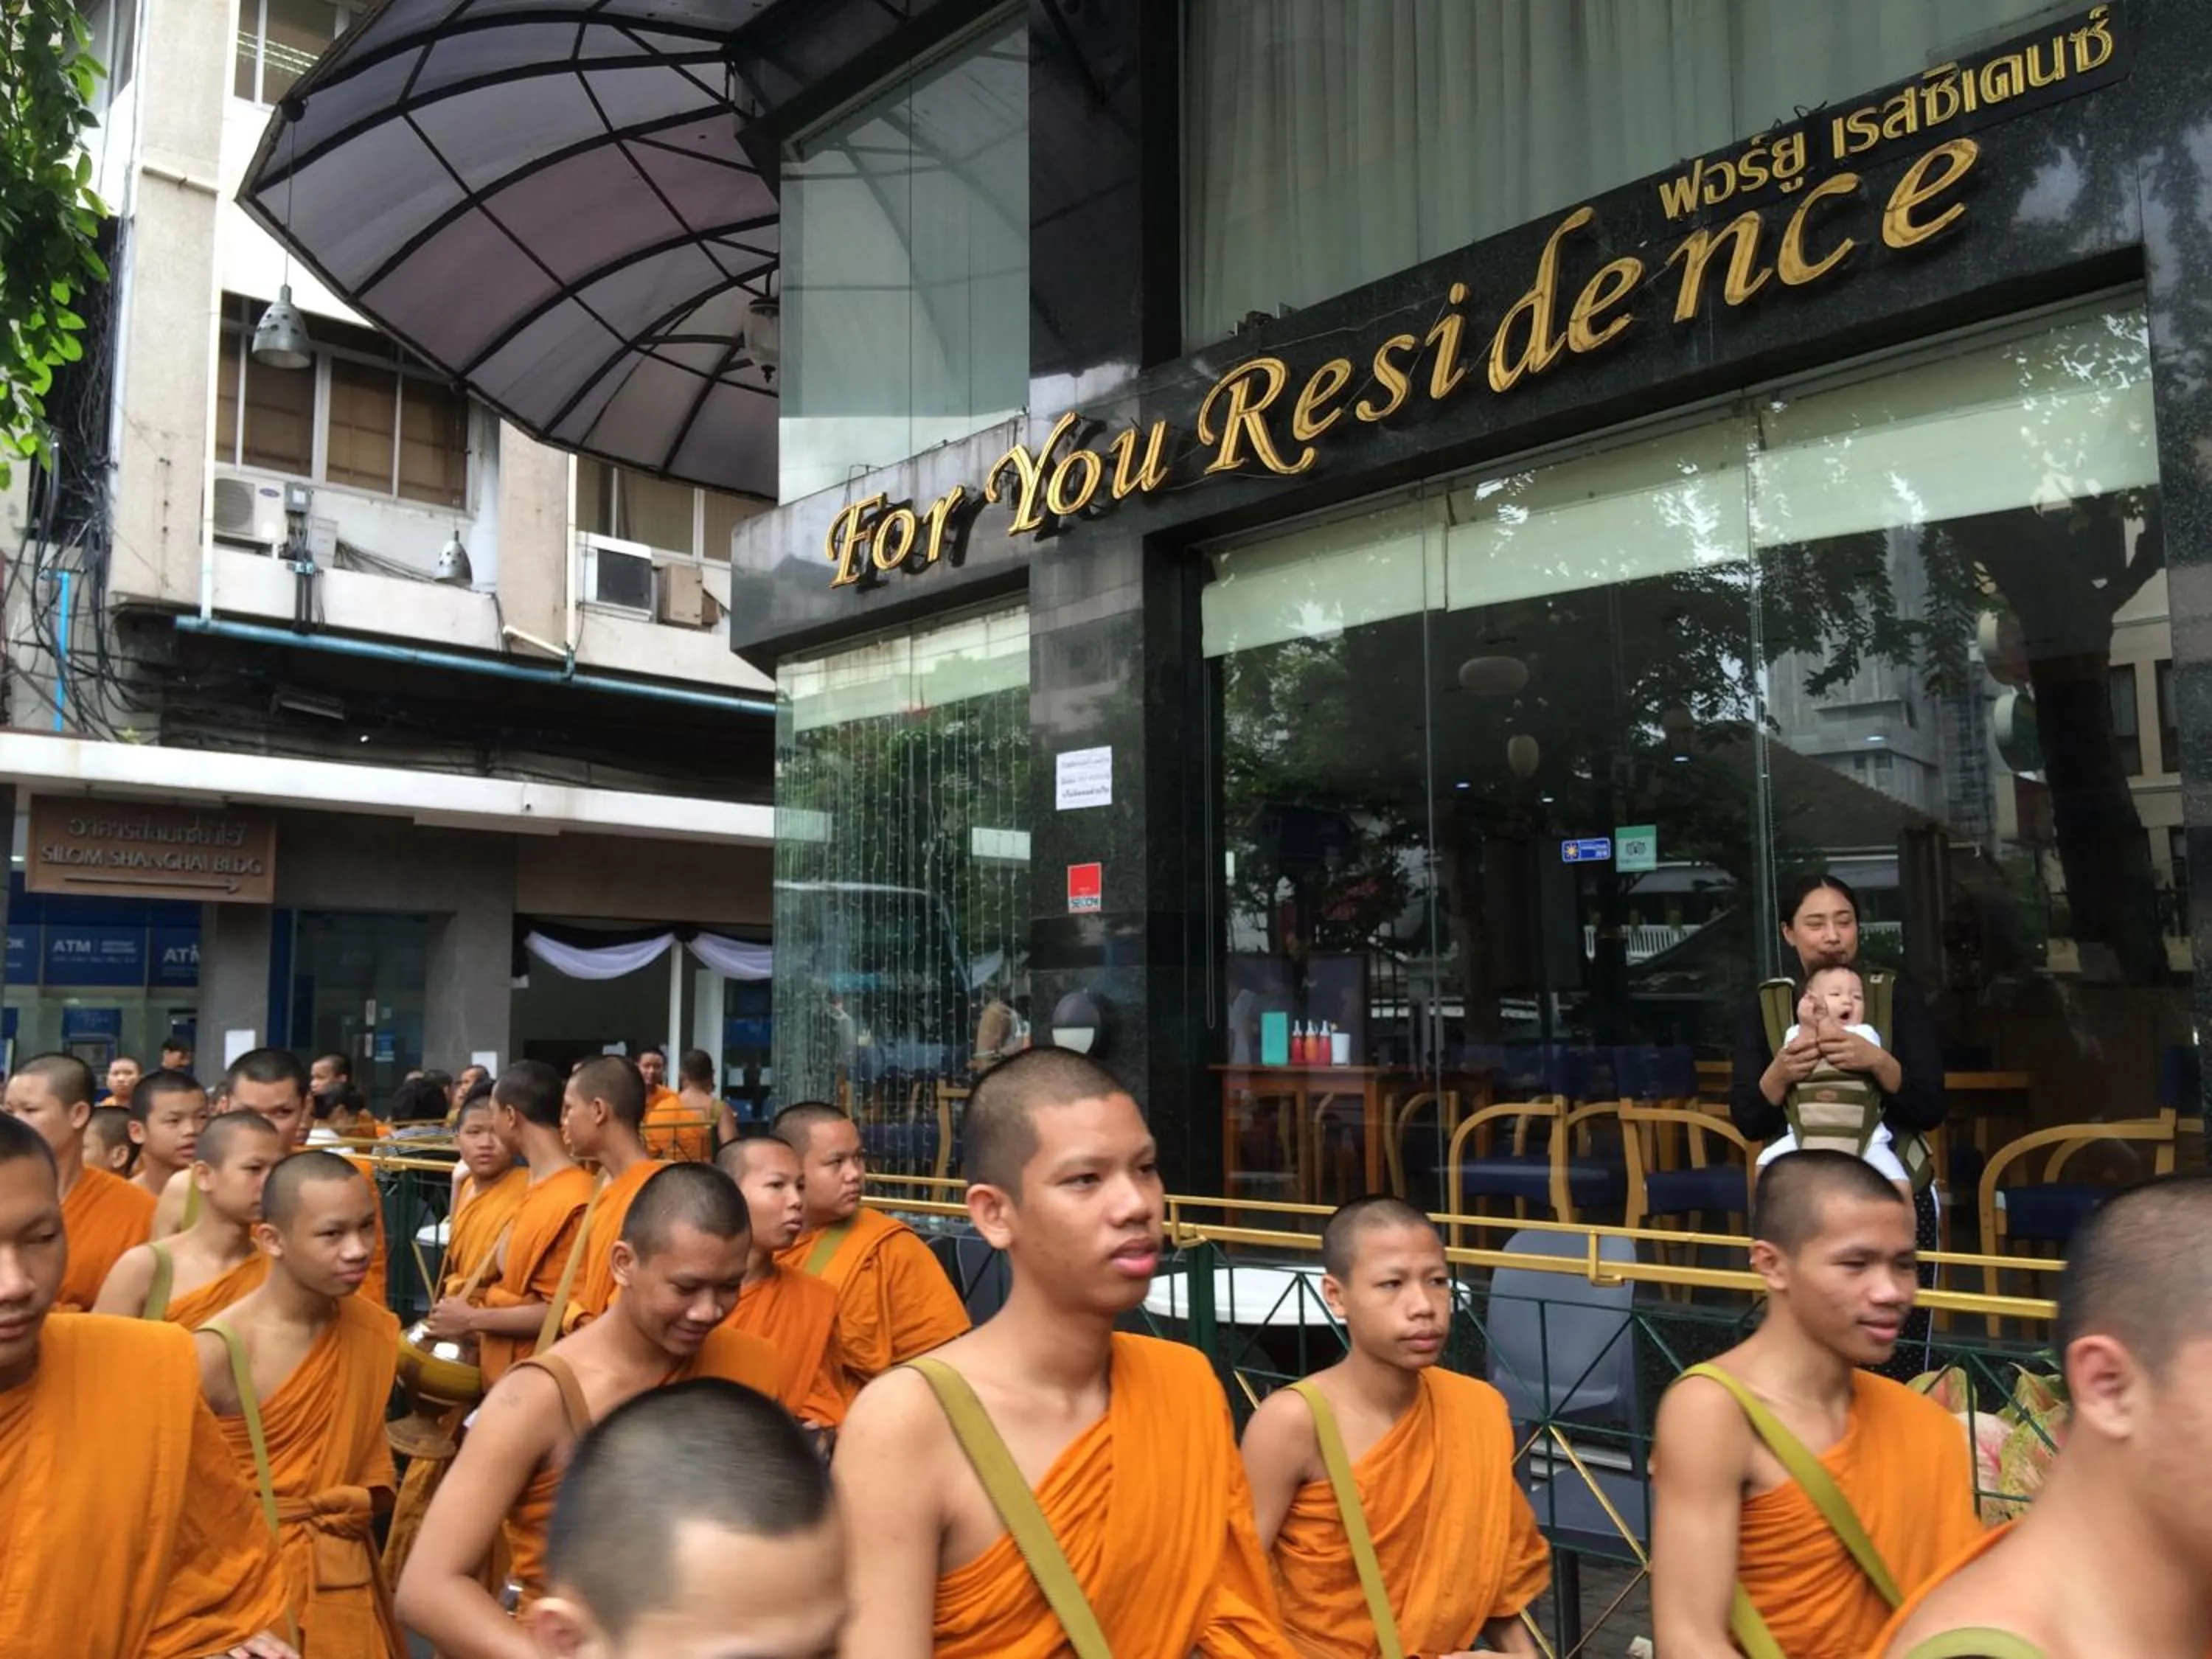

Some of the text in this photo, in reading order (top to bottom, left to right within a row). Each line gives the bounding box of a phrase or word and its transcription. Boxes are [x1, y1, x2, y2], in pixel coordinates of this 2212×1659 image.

[824, 137, 1979, 589] For You Residence
[41, 844, 262, 875] SILOM SHANGHAI BLDG
[52, 939, 91, 953] ATM
